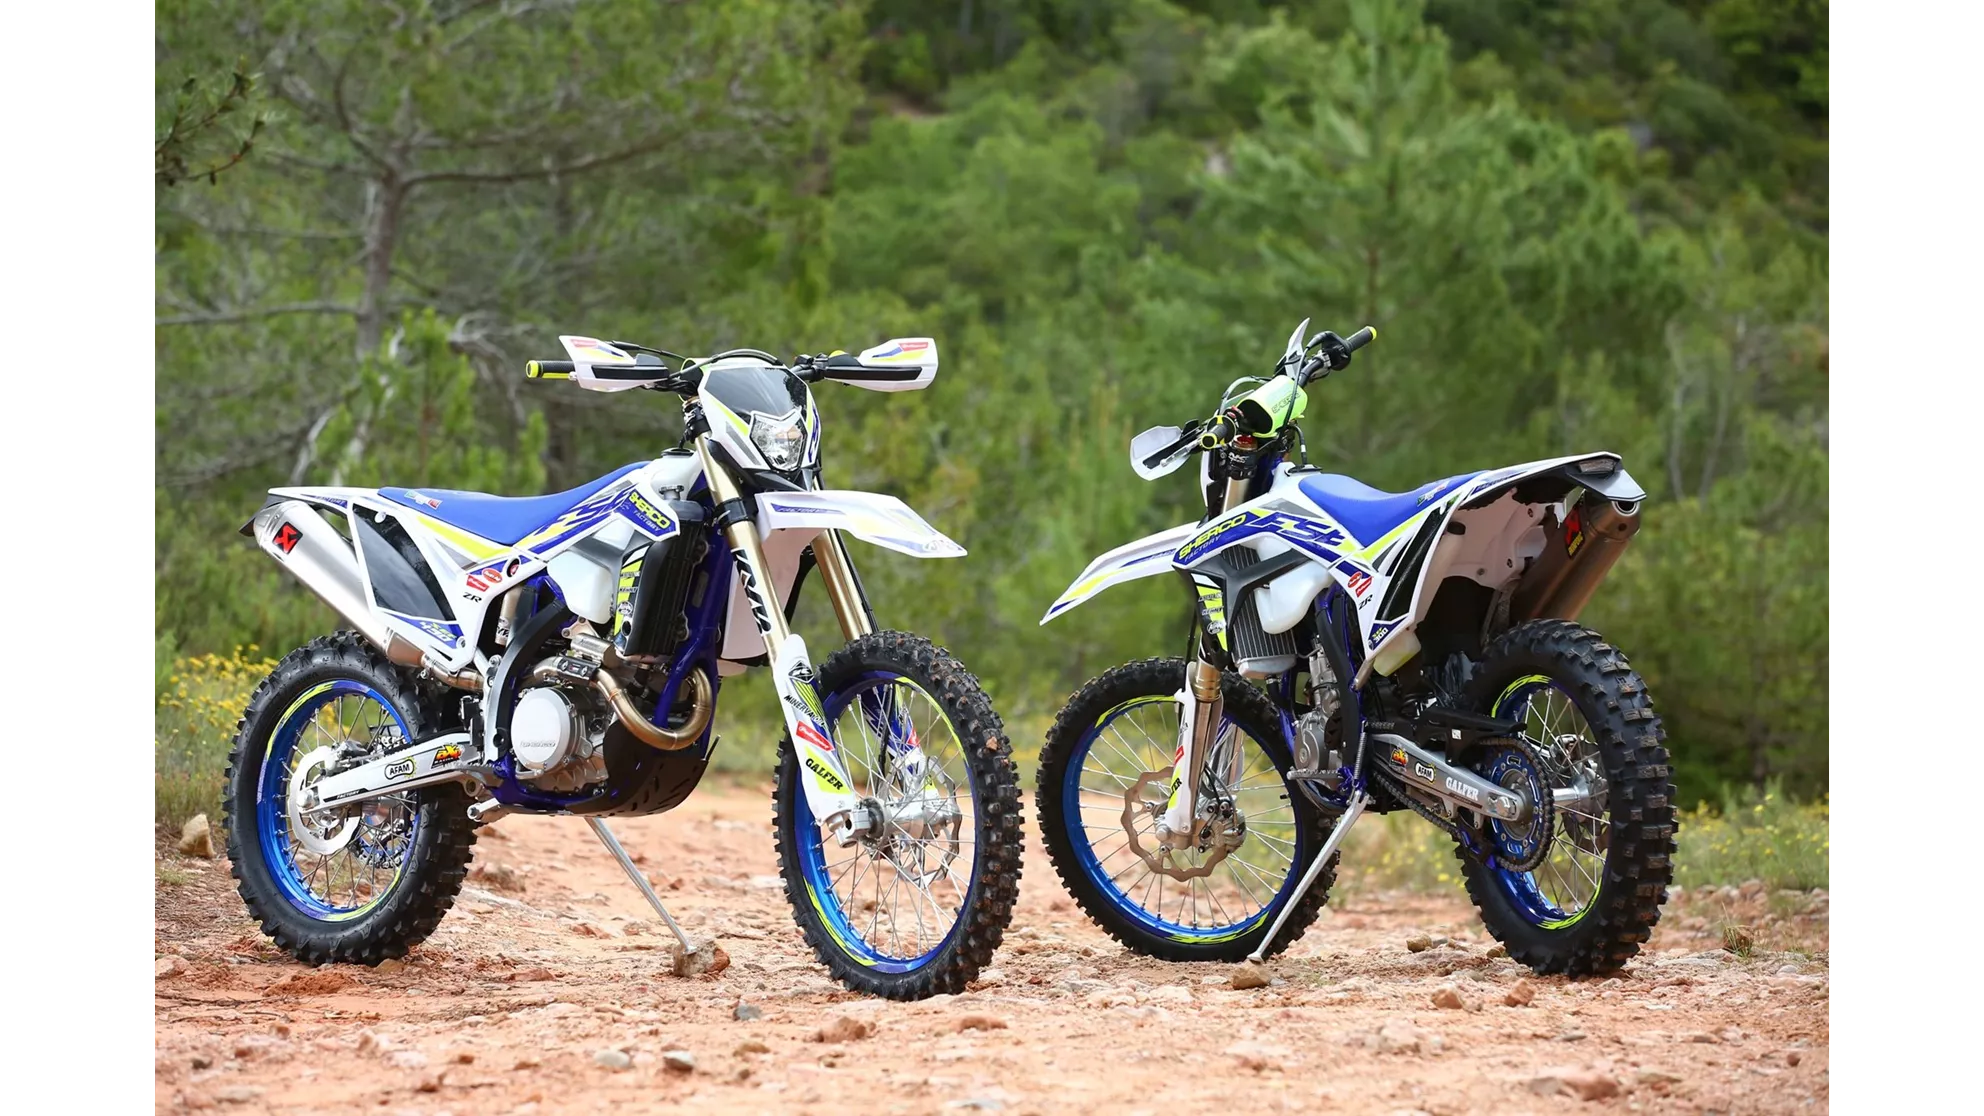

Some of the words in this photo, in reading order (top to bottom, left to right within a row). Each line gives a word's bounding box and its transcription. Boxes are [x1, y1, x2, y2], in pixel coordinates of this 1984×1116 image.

[629, 491, 671, 529] SHERCO
[633, 510, 661, 532] FACTORY
[1179, 514, 1247, 560] SHERCO
[1184, 534, 1221, 562] FACTORY
[463, 592, 482, 603] ZR
[1358, 594, 1373, 610] ZR
[1374, 627, 1389, 644] 300
[783, 694, 814, 720] MINERVA
[389, 763, 410, 775] AFAM
[805, 758, 844, 790] GALFER
[1418, 766, 1432, 778] AFAM
[1446, 777, 1479, 801] GALFER
